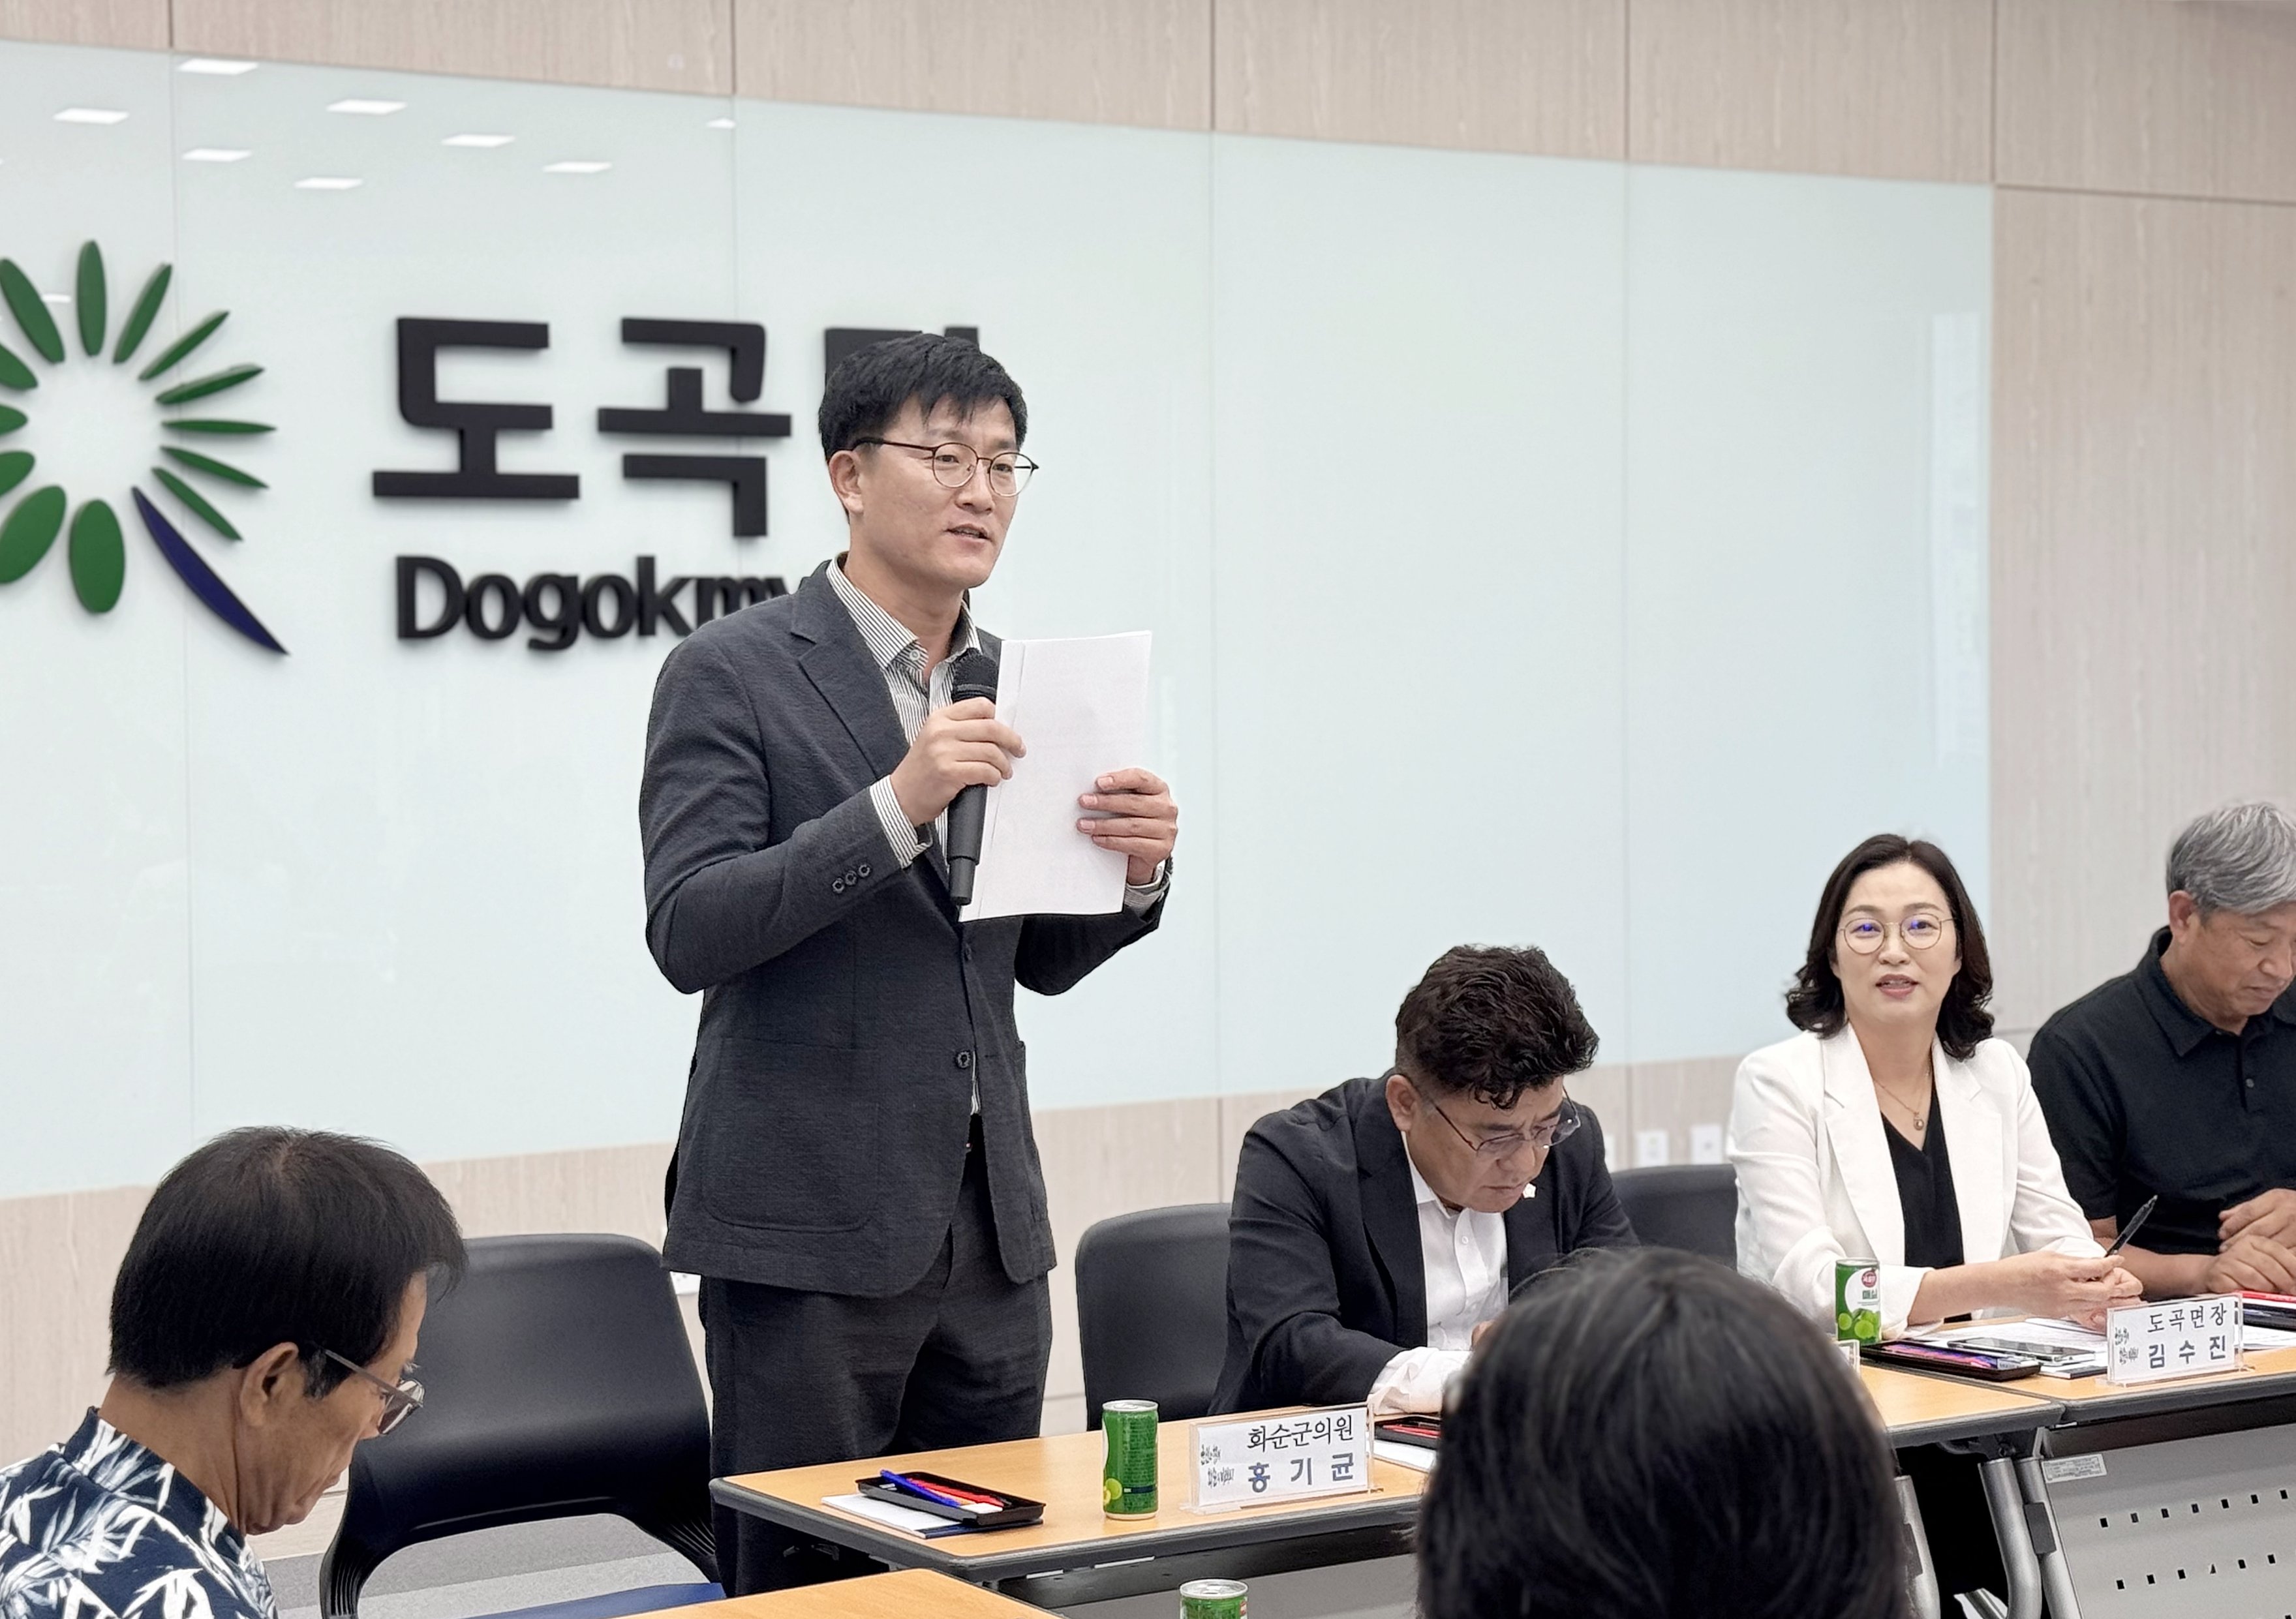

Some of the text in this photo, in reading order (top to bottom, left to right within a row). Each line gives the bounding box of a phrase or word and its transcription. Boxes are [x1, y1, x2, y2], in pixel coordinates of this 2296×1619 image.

[373, 317, 979, 537] 도곡
[397, 556, 788, 650] Dogokm
[2147, 1303, 2227, 1333] 도곡면장
[2149, 1335, 2226, 1369] 김수진
[1247, 1414, 1353, 1453] 화순군의원
